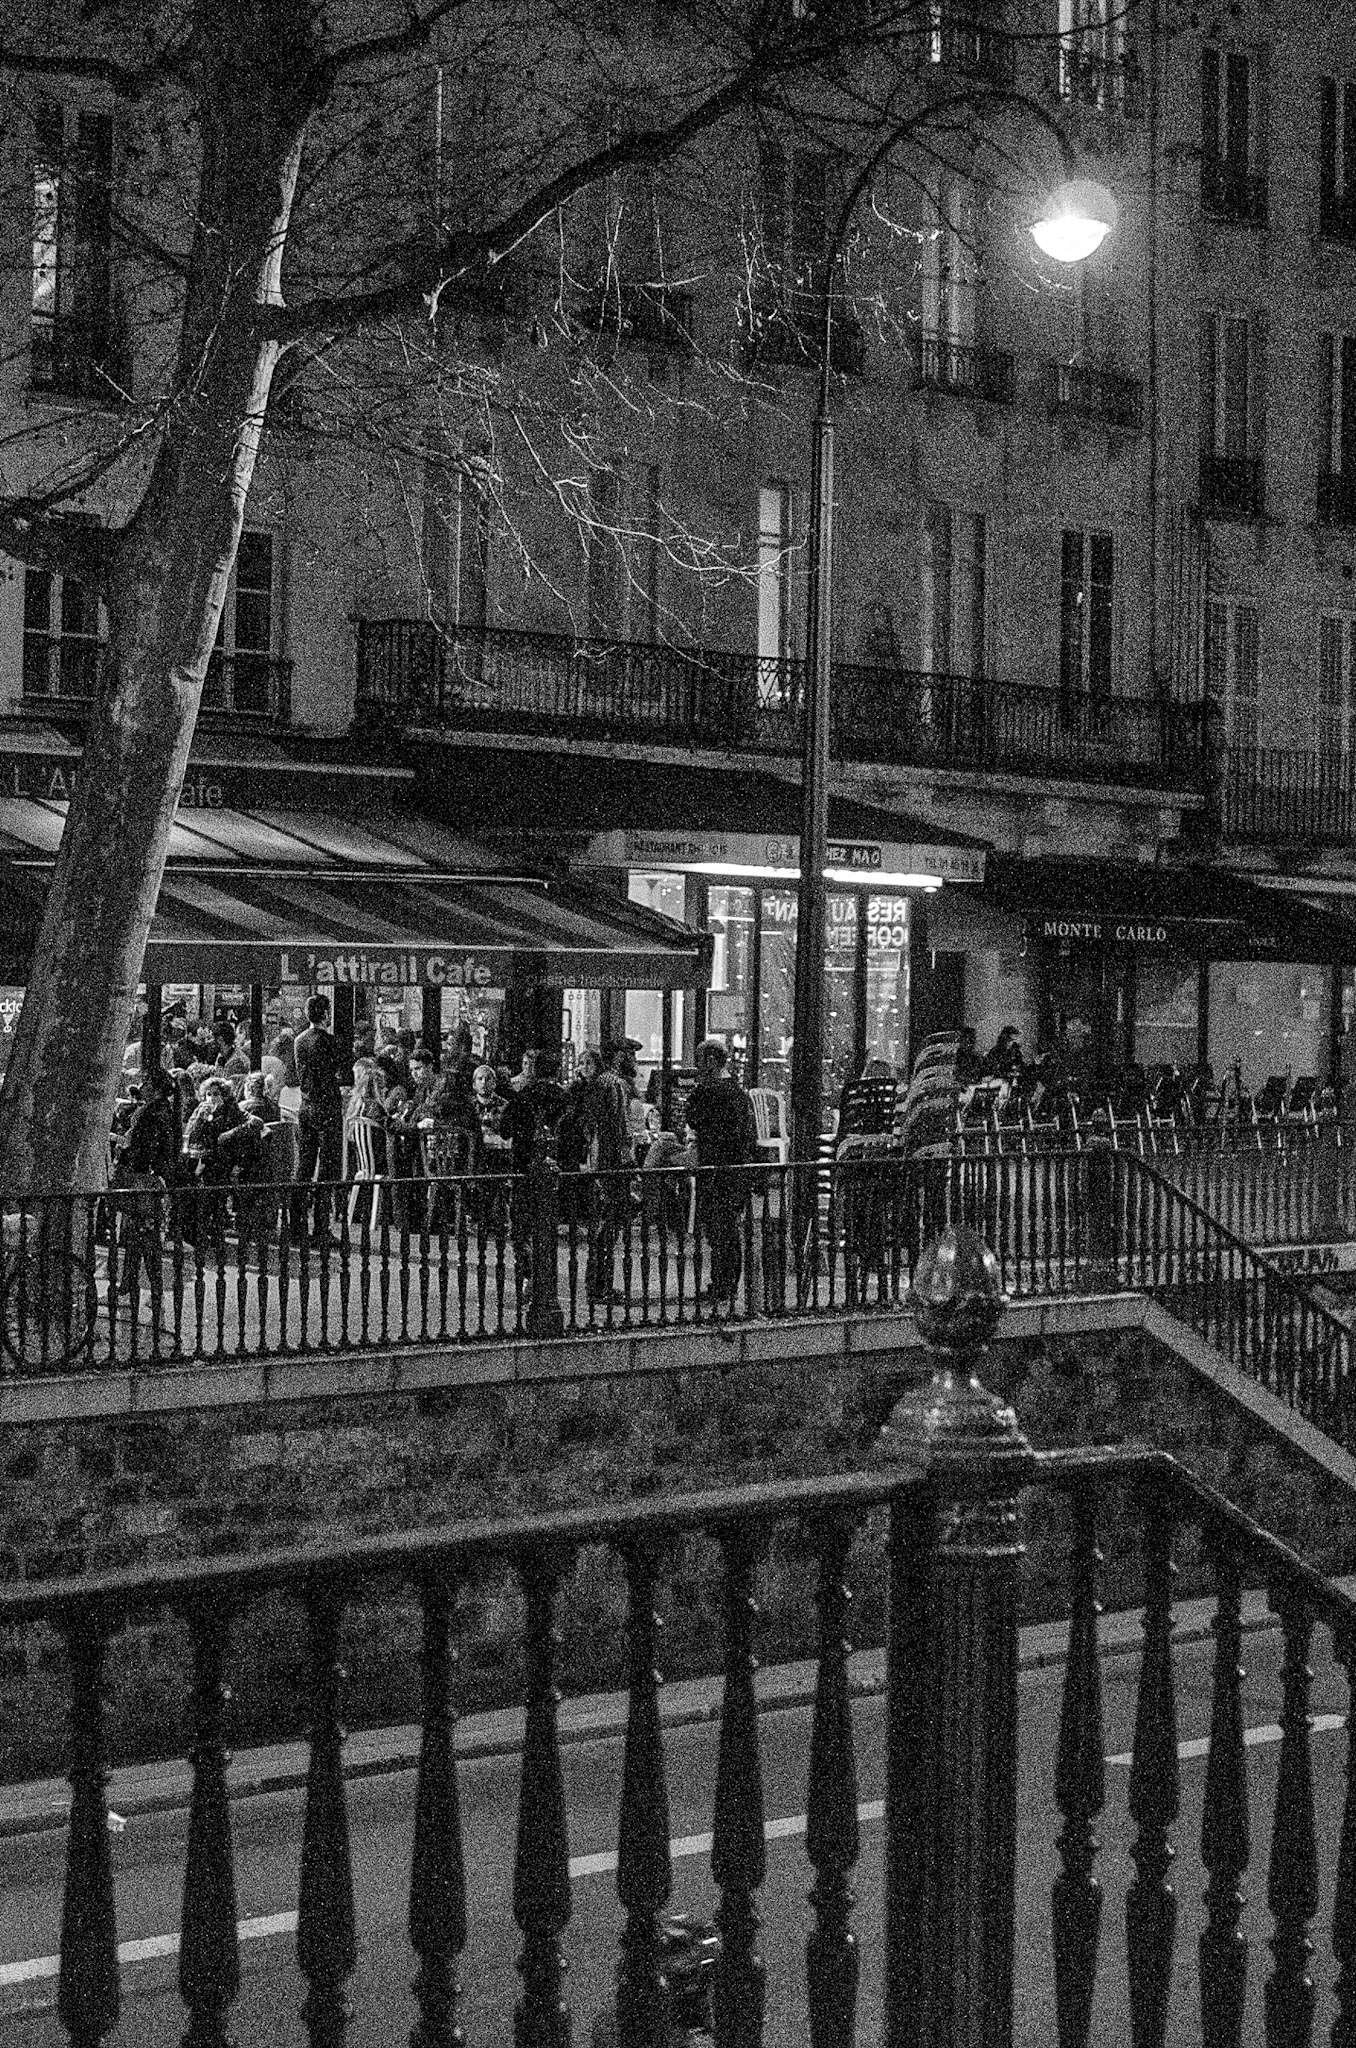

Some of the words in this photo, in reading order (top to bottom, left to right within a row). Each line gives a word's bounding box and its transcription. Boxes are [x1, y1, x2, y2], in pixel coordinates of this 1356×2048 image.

[178, 775, 222, 806] afe
[825, 847, 847, 862] HEZ
[1043, 921, 1102, 939] MONTE
[1115, 925, 1167, 942] CARLO
[425, 956, 490, 985] Cafe
